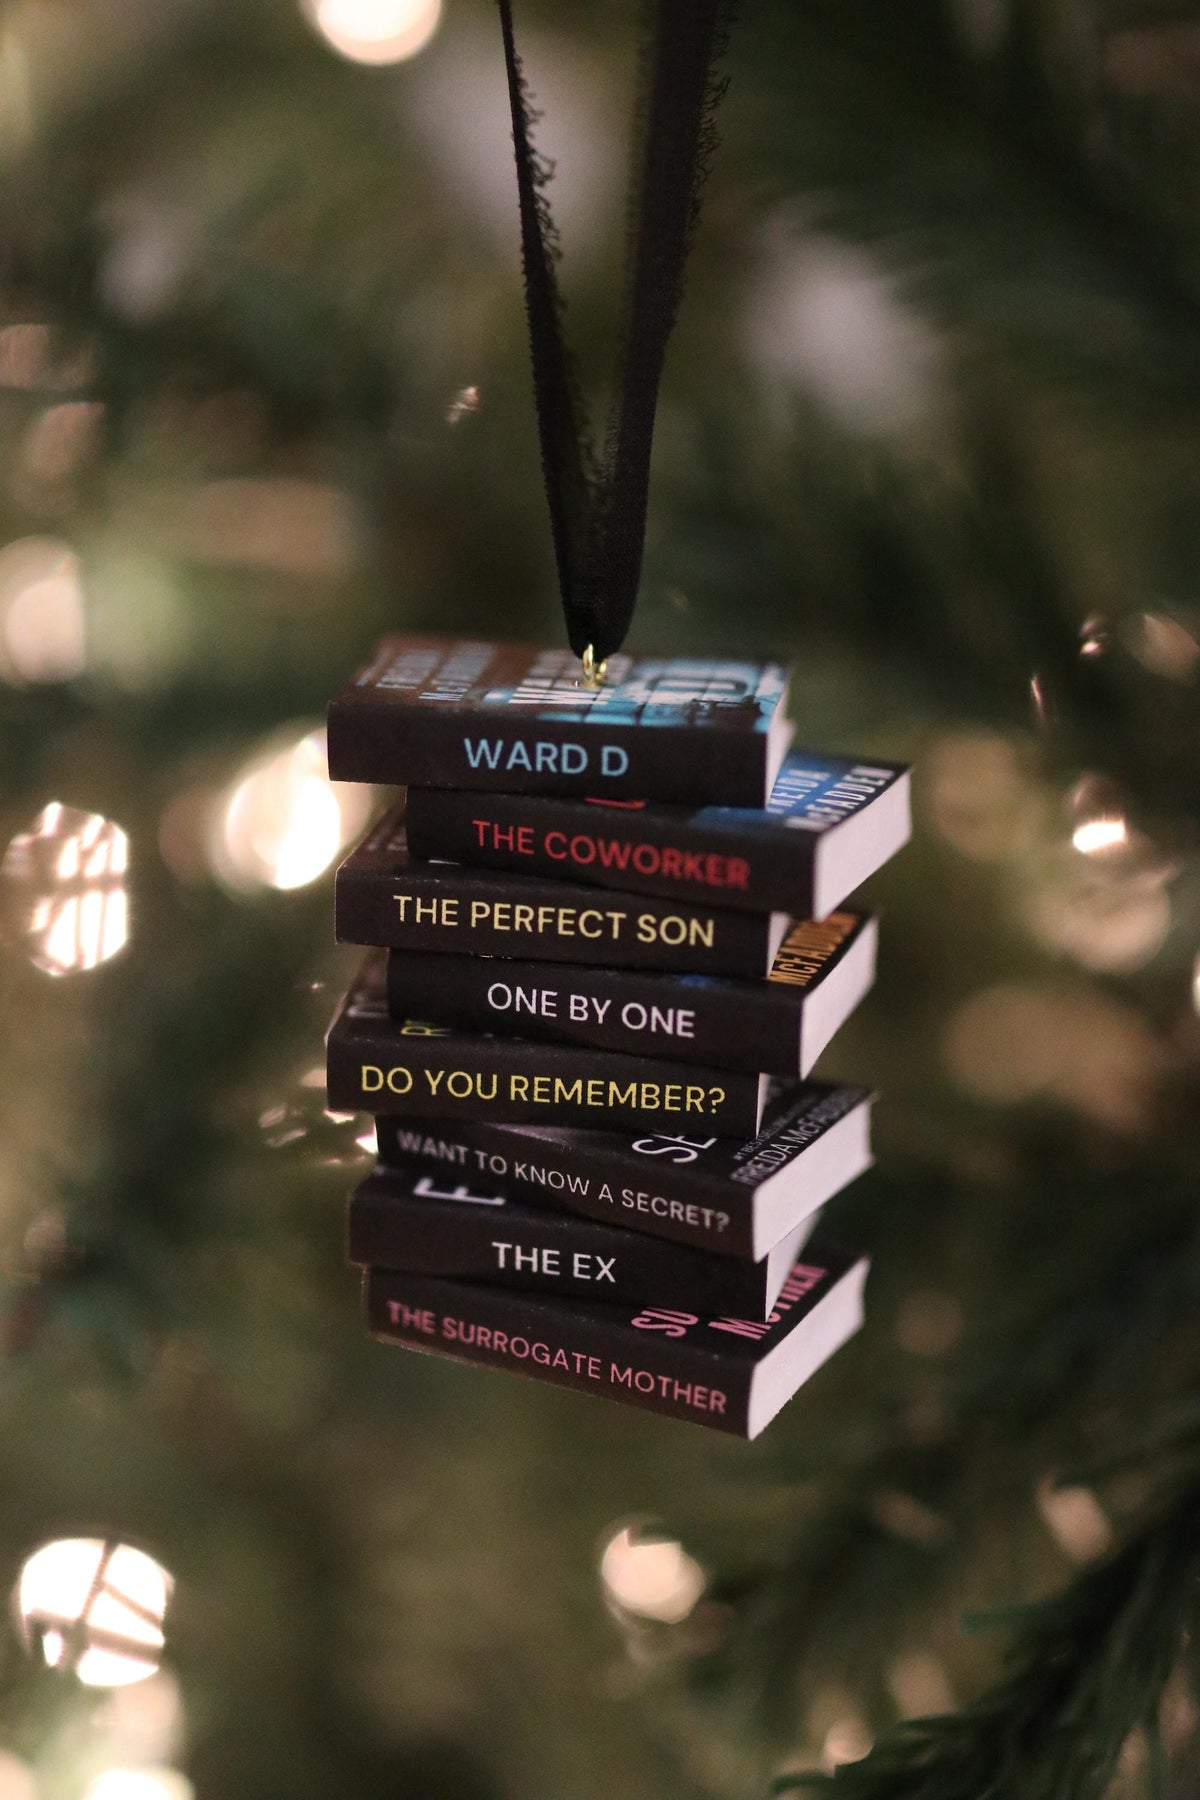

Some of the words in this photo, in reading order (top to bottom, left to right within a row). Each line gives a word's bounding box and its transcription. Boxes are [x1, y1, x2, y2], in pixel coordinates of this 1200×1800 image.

[463, 738, 588, 774] WARD
[601, 745, 629, 777] D
[472, 819, 535, 855] THE
[543, 831, 749, 887] COWORKER
[392, 895, 459, 926] THE
[470, 901, 627, 939] PERFECT
[637, 913, 714, 948] SON
[487, 982, 558, 1018] ONE
[569, 994, 612, 1024] BY
[621, 1002, 695, 1038] ONE
[361, 1065, 413, 1094] DO
[424, 1069, 498, 1100] YOU
[510, 1075, 726, 1114] REMEMBER?
[398, 1131, 469, 1164] WANT
[474, 1150, 508, 1175] TO
[514, 1162, 590, 1196] KNOW
[598, 1183, 614, 1204] A
[621, 1188, 730, 1230] SECRET?
[491, 1241, 561, 1276] THE
[573, 1252, 616, 1283] EX
[386, 1300, 436, 1335] THE
[443, 1317, 602, 1380] SURROGATE
[610, 1362, 727, 1413] MOTHER
